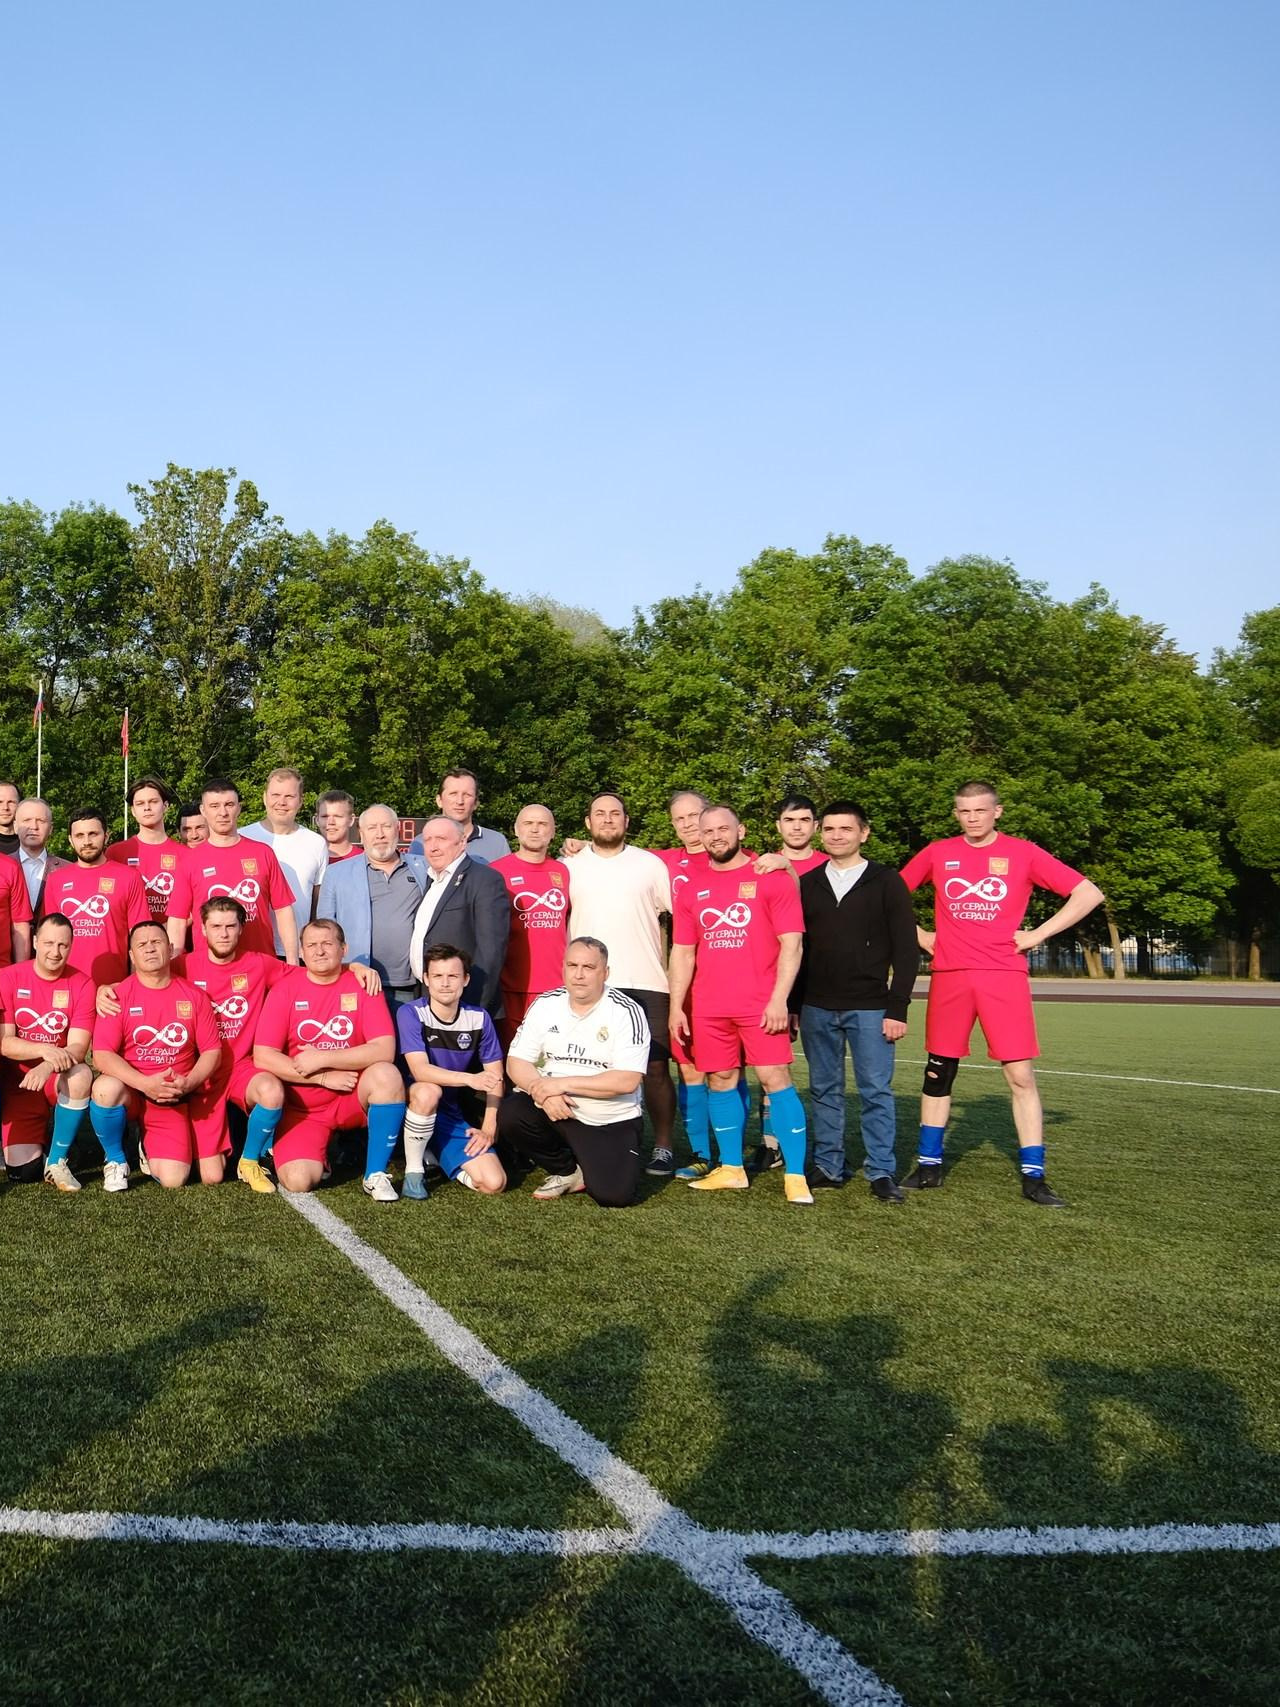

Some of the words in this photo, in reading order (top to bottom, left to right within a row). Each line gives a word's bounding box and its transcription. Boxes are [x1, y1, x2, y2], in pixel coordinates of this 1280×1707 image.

[147, 895, 169, 904] ЕРДЦА
[962, 902, 1000, 910] СЕРДЦА
[519, 912, 530, 920] ОТ
[533, 912, 562, 920] СЕРДЦА
[960, 912, 996, 920] СЕРДЦУ
[75, 919, 105, 927] СЕРДЦА
[531, 920, 560, 928] СЕРДЦУ
[73, 928, 102, 937] СЕРДЦУ
[704, 931, 714, 940] ОТ
[716, 929, 747, 938] СЕРДЦА
[714, 940, 744, 949] СЕРДЦУ
[217, 1020, 243, 1029] ЕРДЦА
[30, 1032, 61, 1042] СЕРДЦА
[317, 1042, 350, 1050] СЕРДЦА
[568, 1043, 586, 1056] Fly
